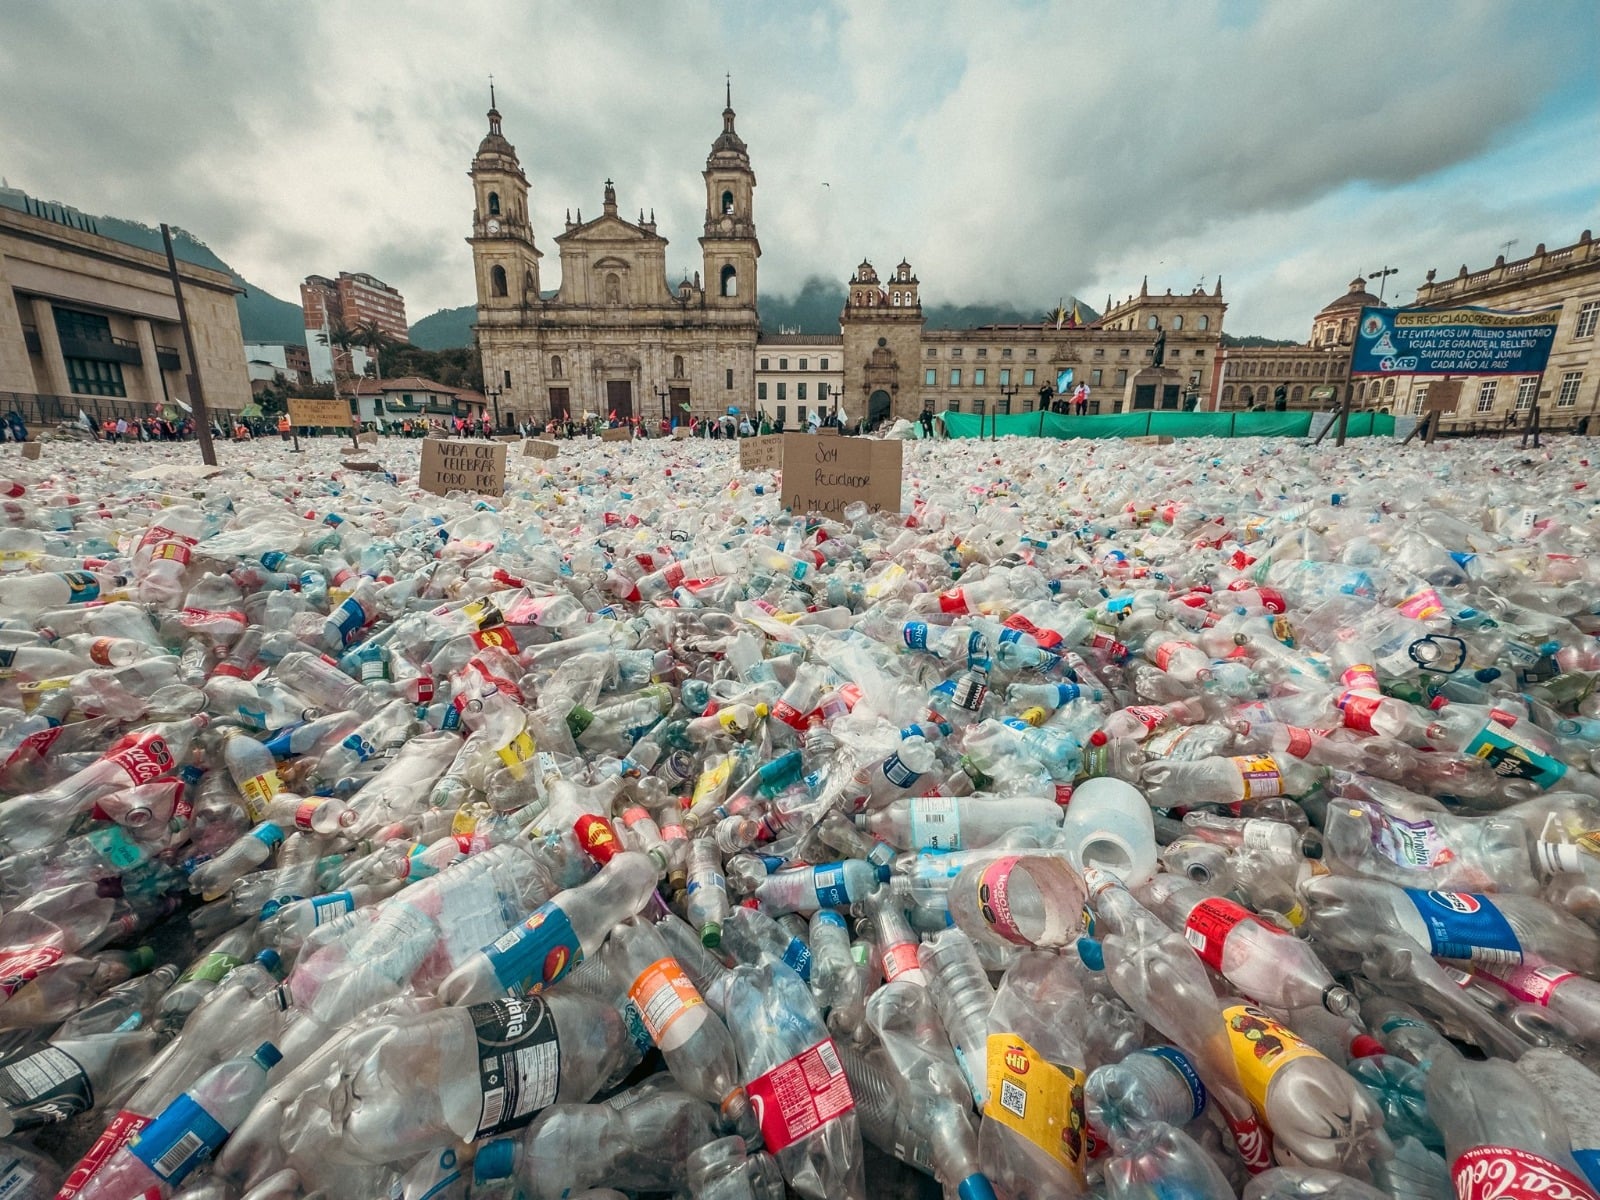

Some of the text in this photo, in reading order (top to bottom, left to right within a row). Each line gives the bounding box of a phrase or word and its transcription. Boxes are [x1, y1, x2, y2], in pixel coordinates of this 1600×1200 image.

[1393, 316, 1414, 325] LOS
[1416, 313, 1492, 325] RECICLADORES
[1493, 316, 1508, 325] DE
[1397, 328, 1552, 339] LE EVITAMOS UN RELLENO SANITARIO
[1409, 339, 1537, 349] IGUAL DE GRANDE AL RELLENO
[1421, 348, 1522, 359] SANITARIO DOÑA JUANA
[1430, 360, 1455, 369] CADA
[1456, 358, 1478, 369] AÑO
[1478, 360, 1489, 369] AL
[437, 442, 495, 459] NADA QUE
[443, 459, 496, 473] CELEBRAR
[436, 472, 497, 487] TODO POR
[793, 494, 801, 511] A
[1446, 891, 1468, 911] EPSI
[1464, 1148, 1562, 1173] SABOR ORIGINAL
